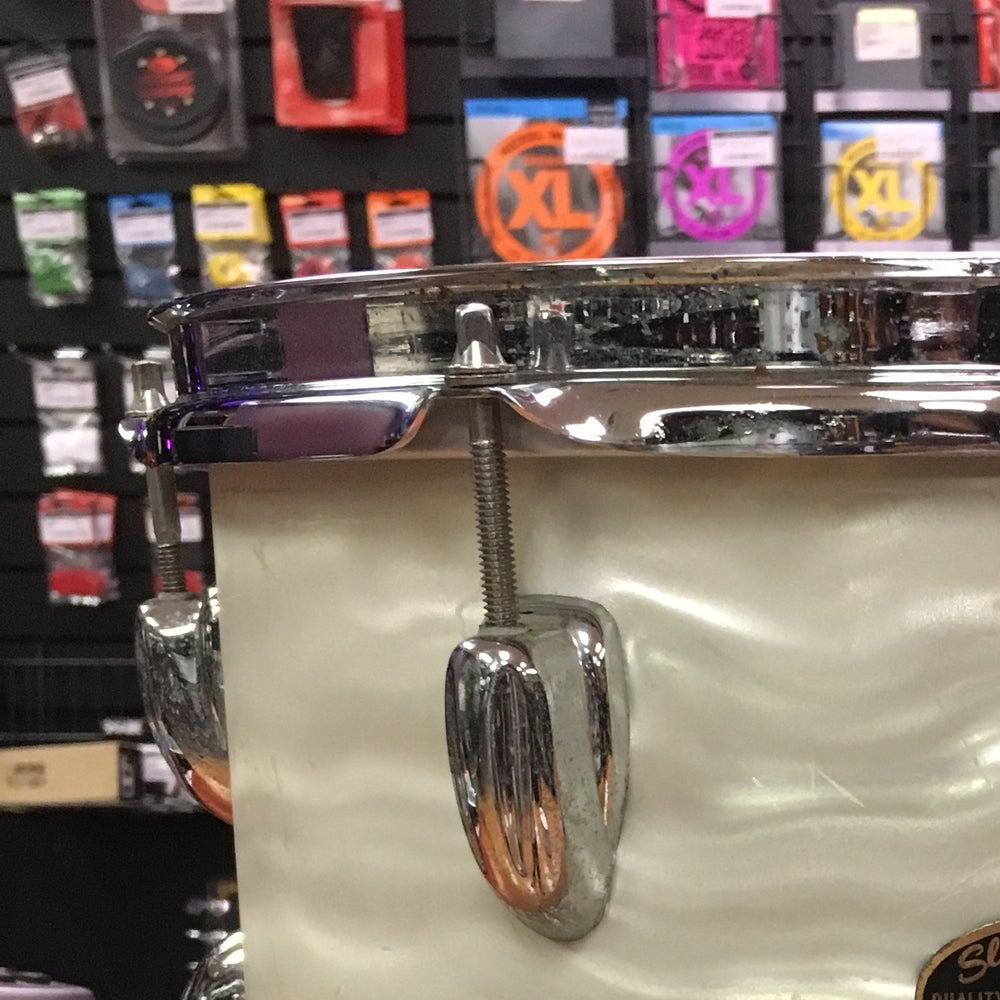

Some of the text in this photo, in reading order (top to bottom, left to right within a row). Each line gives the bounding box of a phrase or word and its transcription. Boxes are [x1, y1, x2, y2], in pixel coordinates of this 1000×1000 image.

[508, 168, 592, 229] XL
[680, 162, 746, 206] XL
[853, 169, 913, 212] XL
